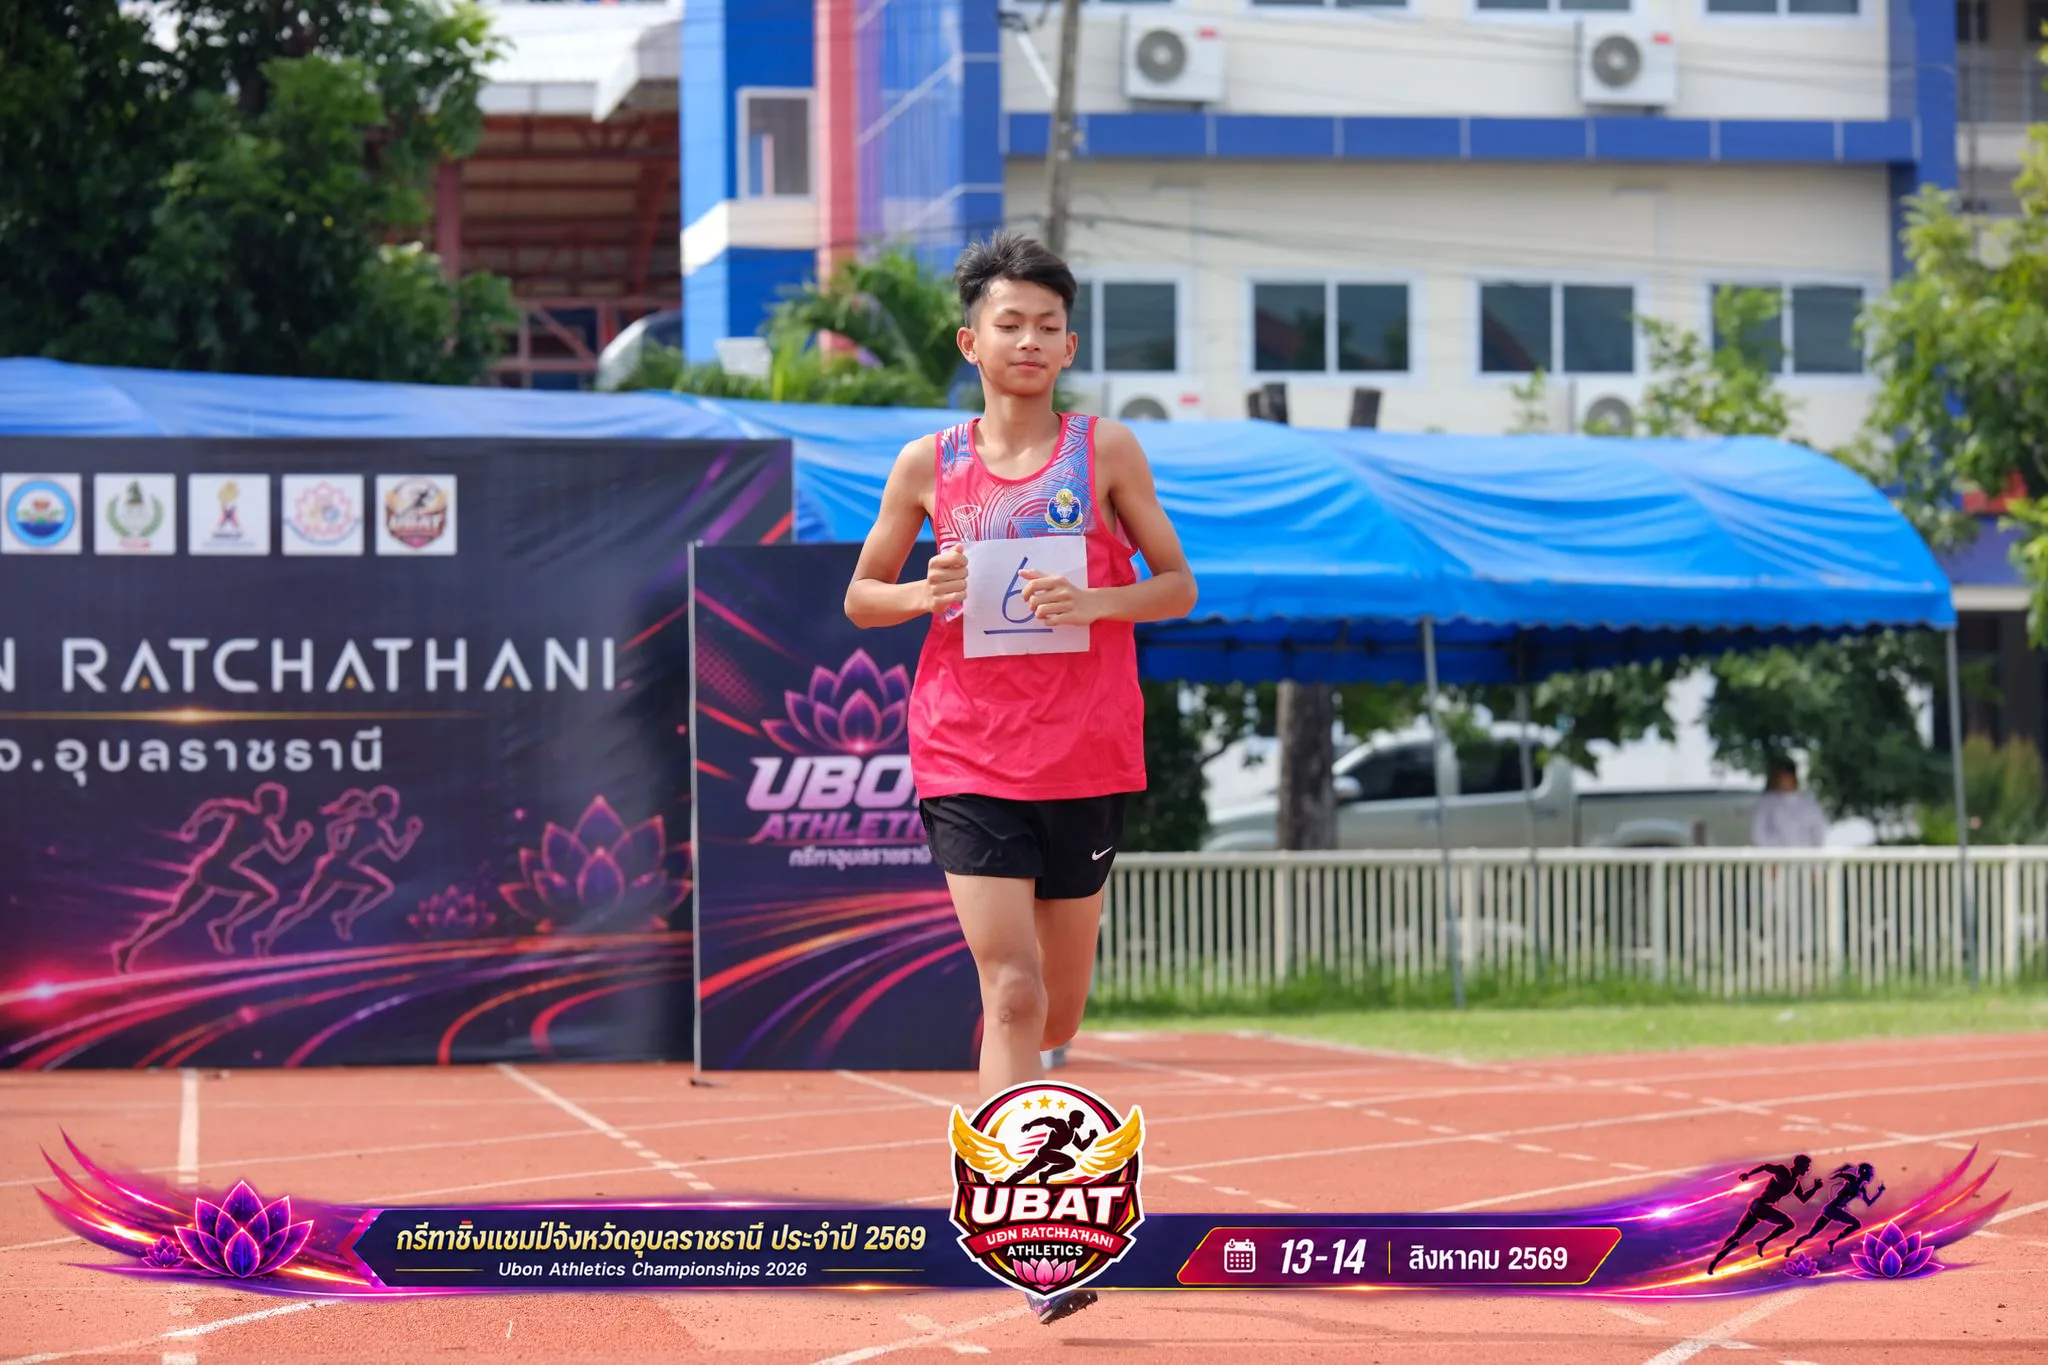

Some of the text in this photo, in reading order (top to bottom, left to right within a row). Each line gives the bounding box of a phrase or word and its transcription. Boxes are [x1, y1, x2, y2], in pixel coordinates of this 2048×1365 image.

[61, 637, 616, 692] RATCHATHANI
[746, 755, 919, 811] UBO
[752, 812, 927, 842] ATHLETI
